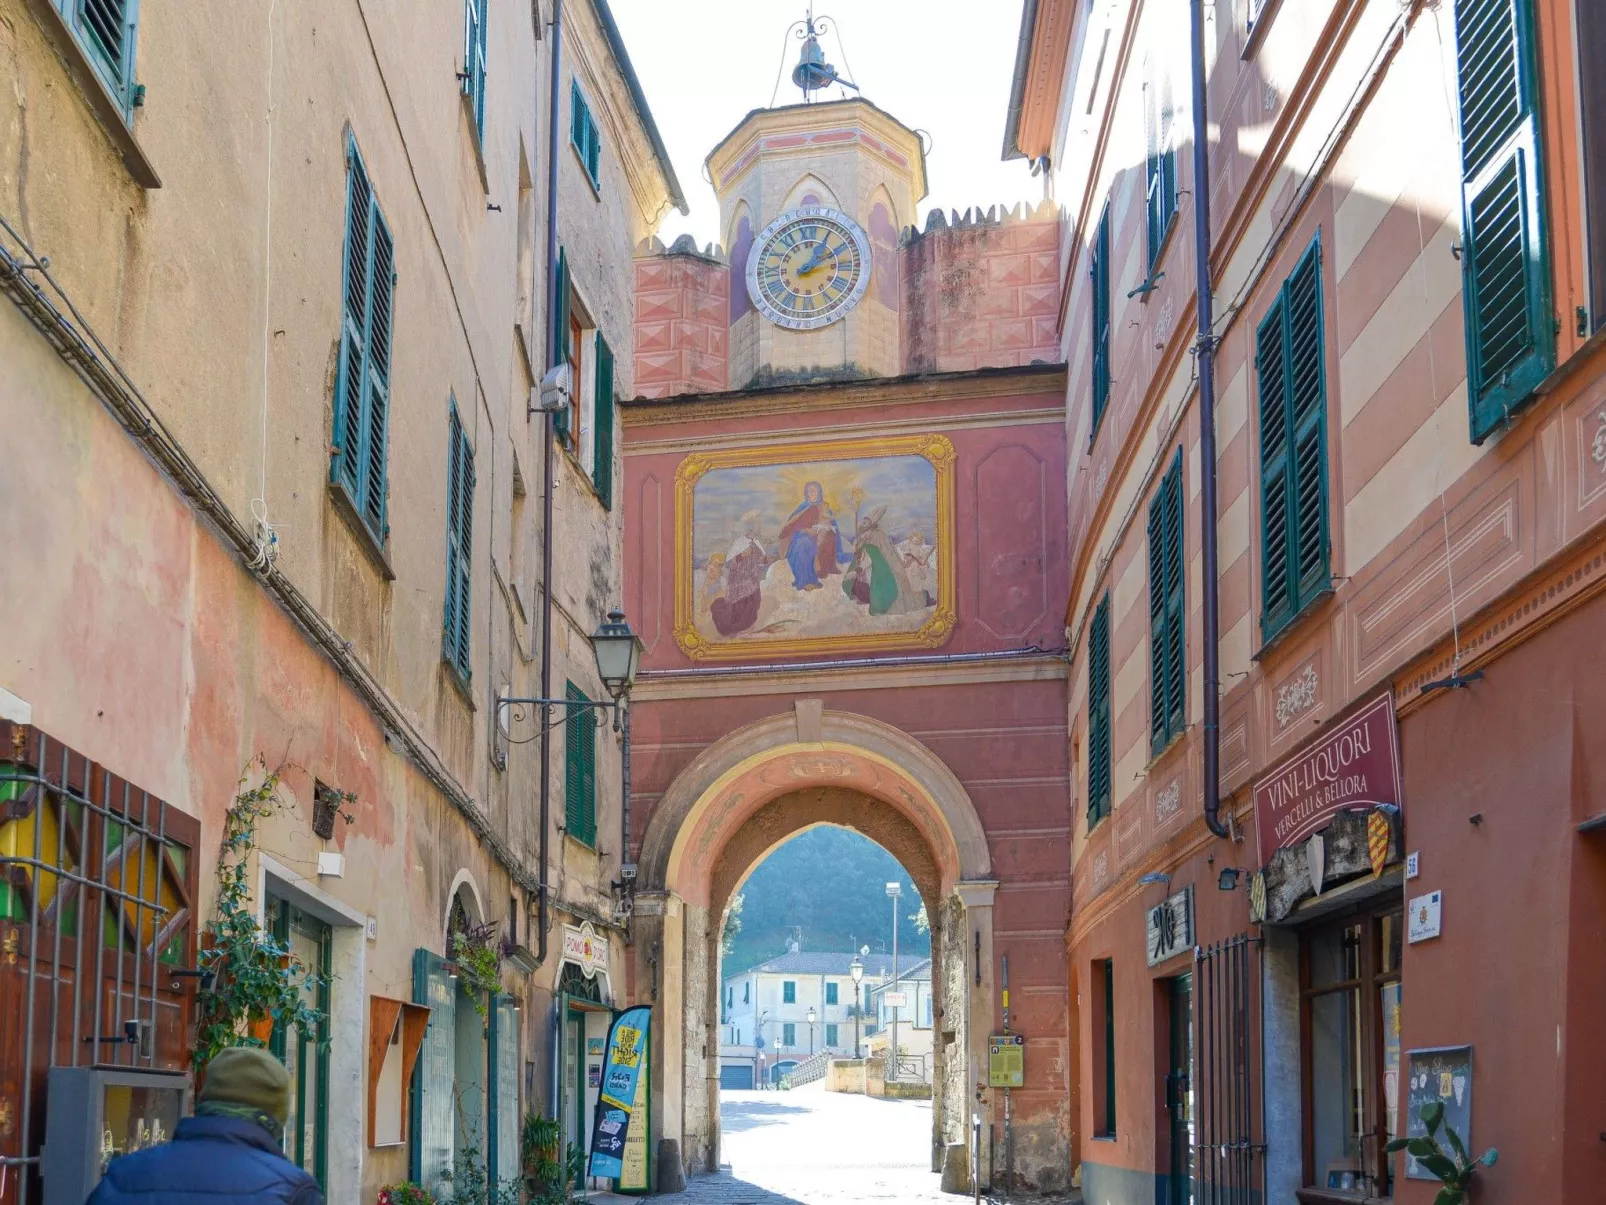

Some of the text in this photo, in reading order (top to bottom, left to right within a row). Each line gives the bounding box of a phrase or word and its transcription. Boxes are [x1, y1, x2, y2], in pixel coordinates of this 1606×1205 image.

[1268, 722, 1372, 811] VINI-LIQUORI
[1275, 774, 1368, 840] VERCELLI & BELLORA
